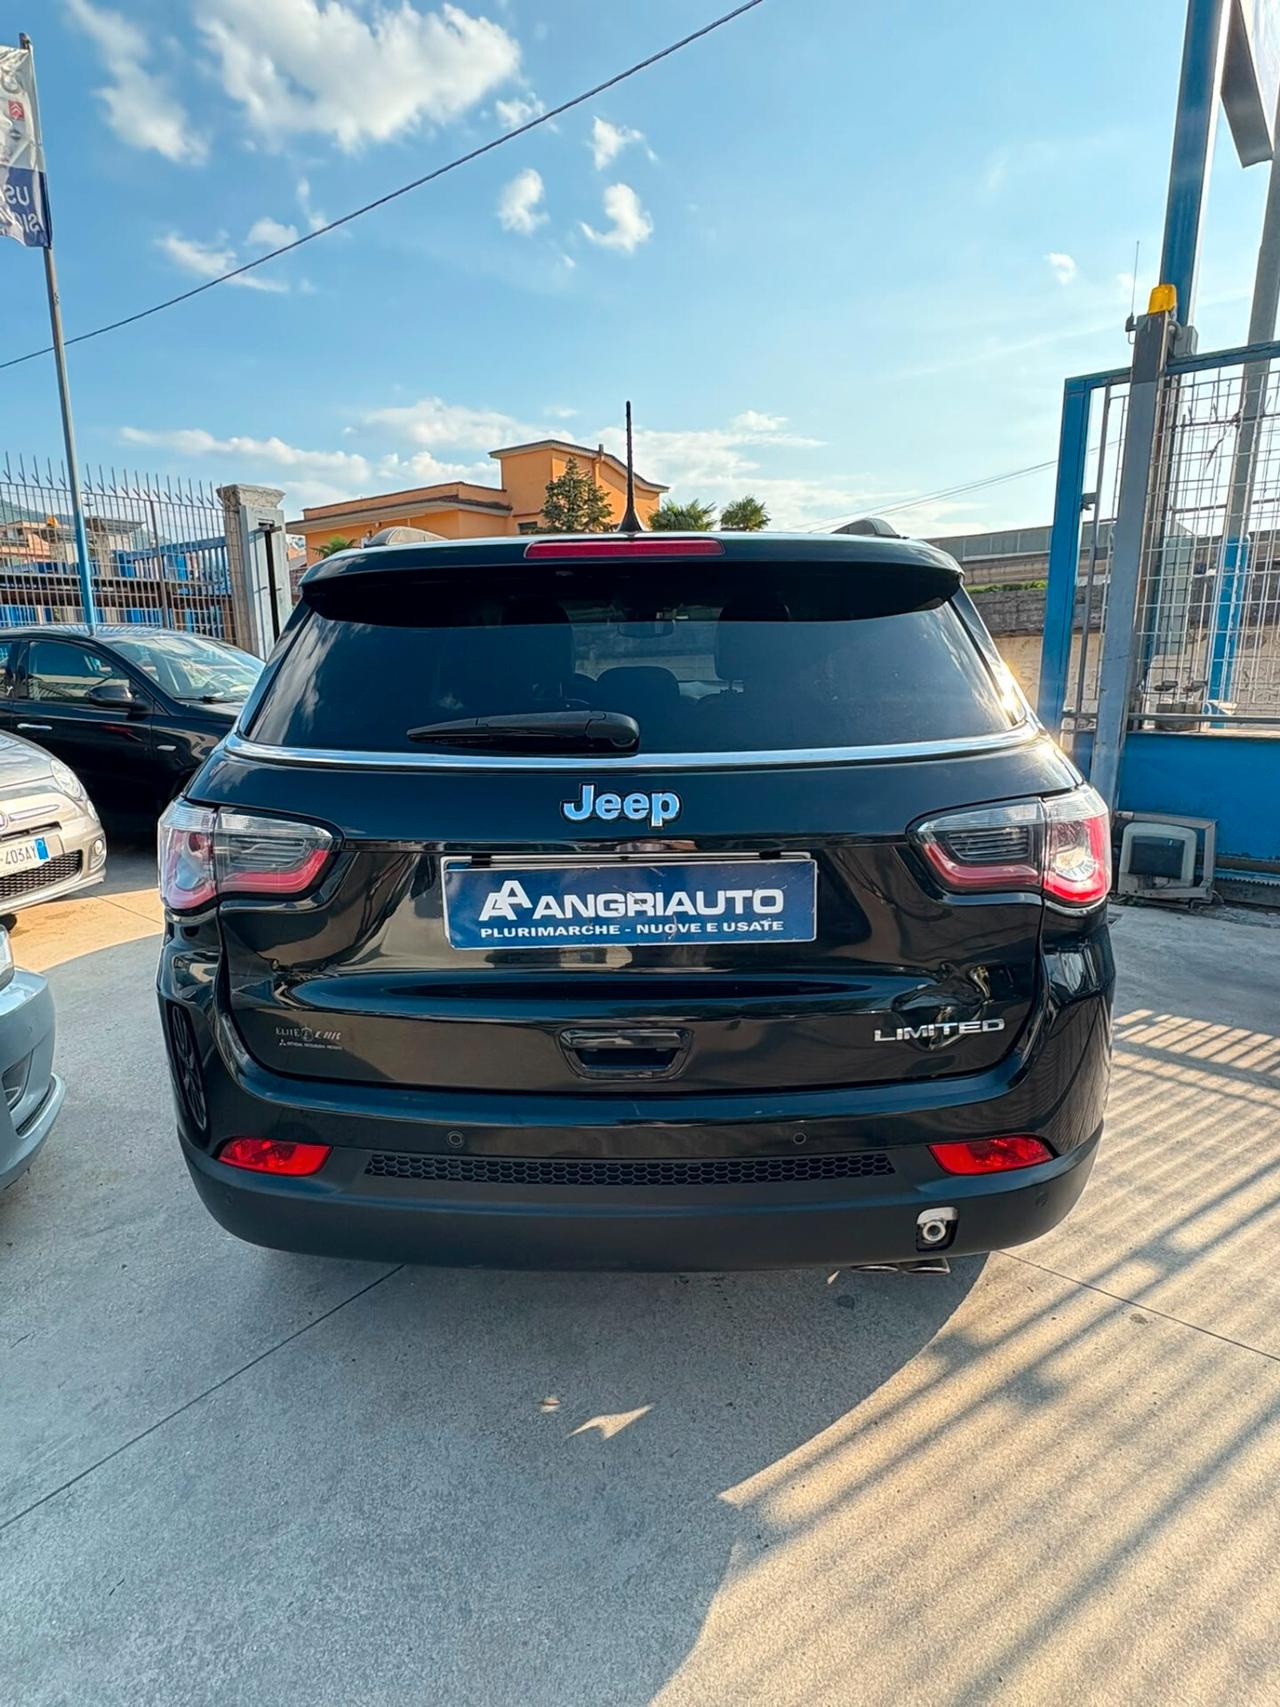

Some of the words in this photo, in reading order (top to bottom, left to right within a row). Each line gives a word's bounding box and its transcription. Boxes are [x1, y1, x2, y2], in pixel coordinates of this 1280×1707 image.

[562, 784, 680, 827] Jeep
[532, 888, 784, 919] ANGRIAUTO
[480, 924, 621, 938] PLURIMARCHE
[636, 922, 702, 934] NUOVE
[706, 922, 718, 933] E
[723, 920, 784, 932] USATE
[874, 1019, 1005, 1041] LIMITED
